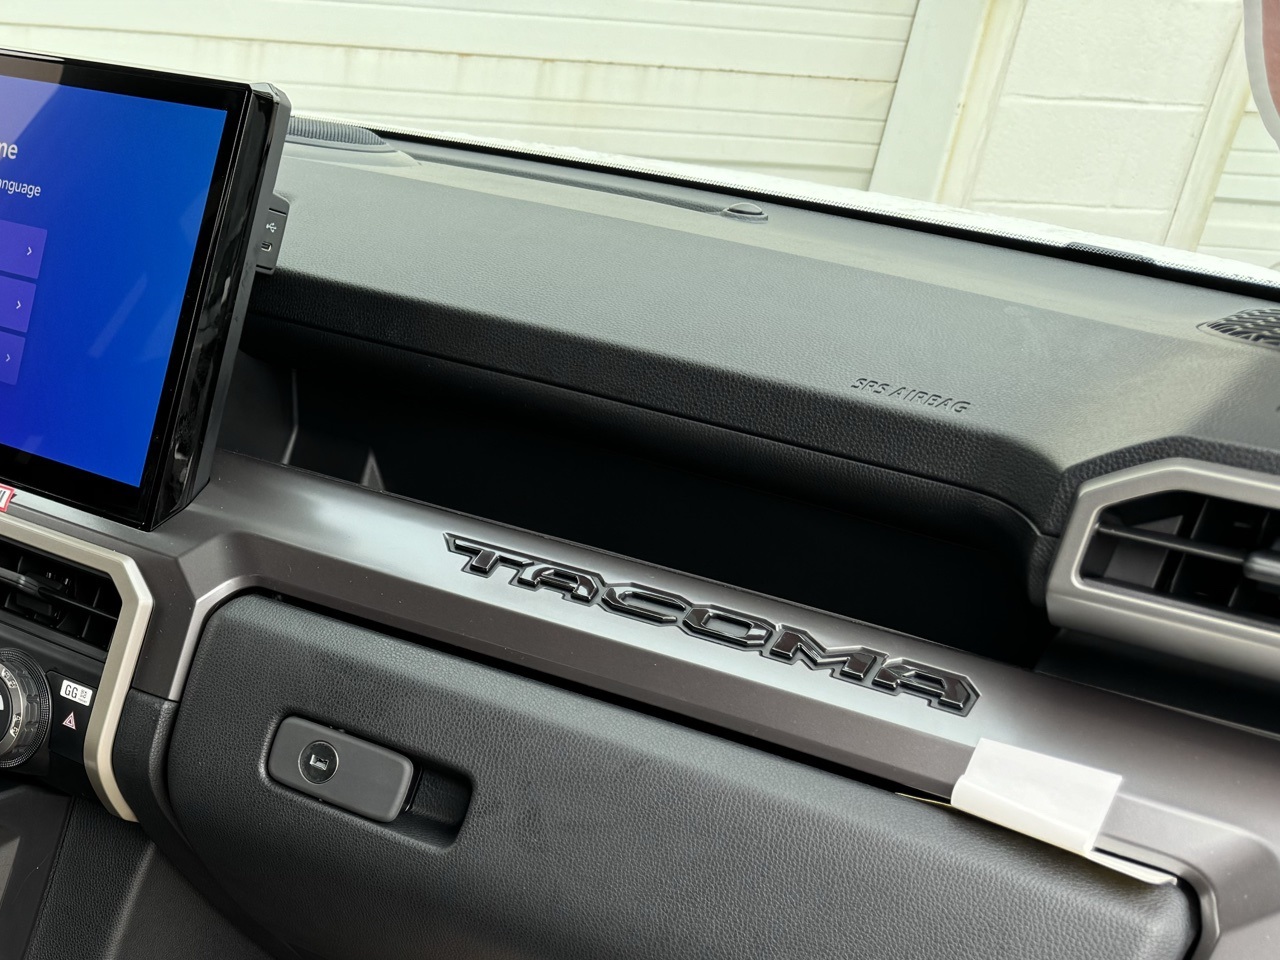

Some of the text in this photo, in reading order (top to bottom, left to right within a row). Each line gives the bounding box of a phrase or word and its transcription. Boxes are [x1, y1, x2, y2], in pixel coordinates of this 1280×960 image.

[851, 378, 970, 412] SRS AIRBAG
[445, 532, 981, 716] TACOMA
[64, 684, 78, 699] GG
